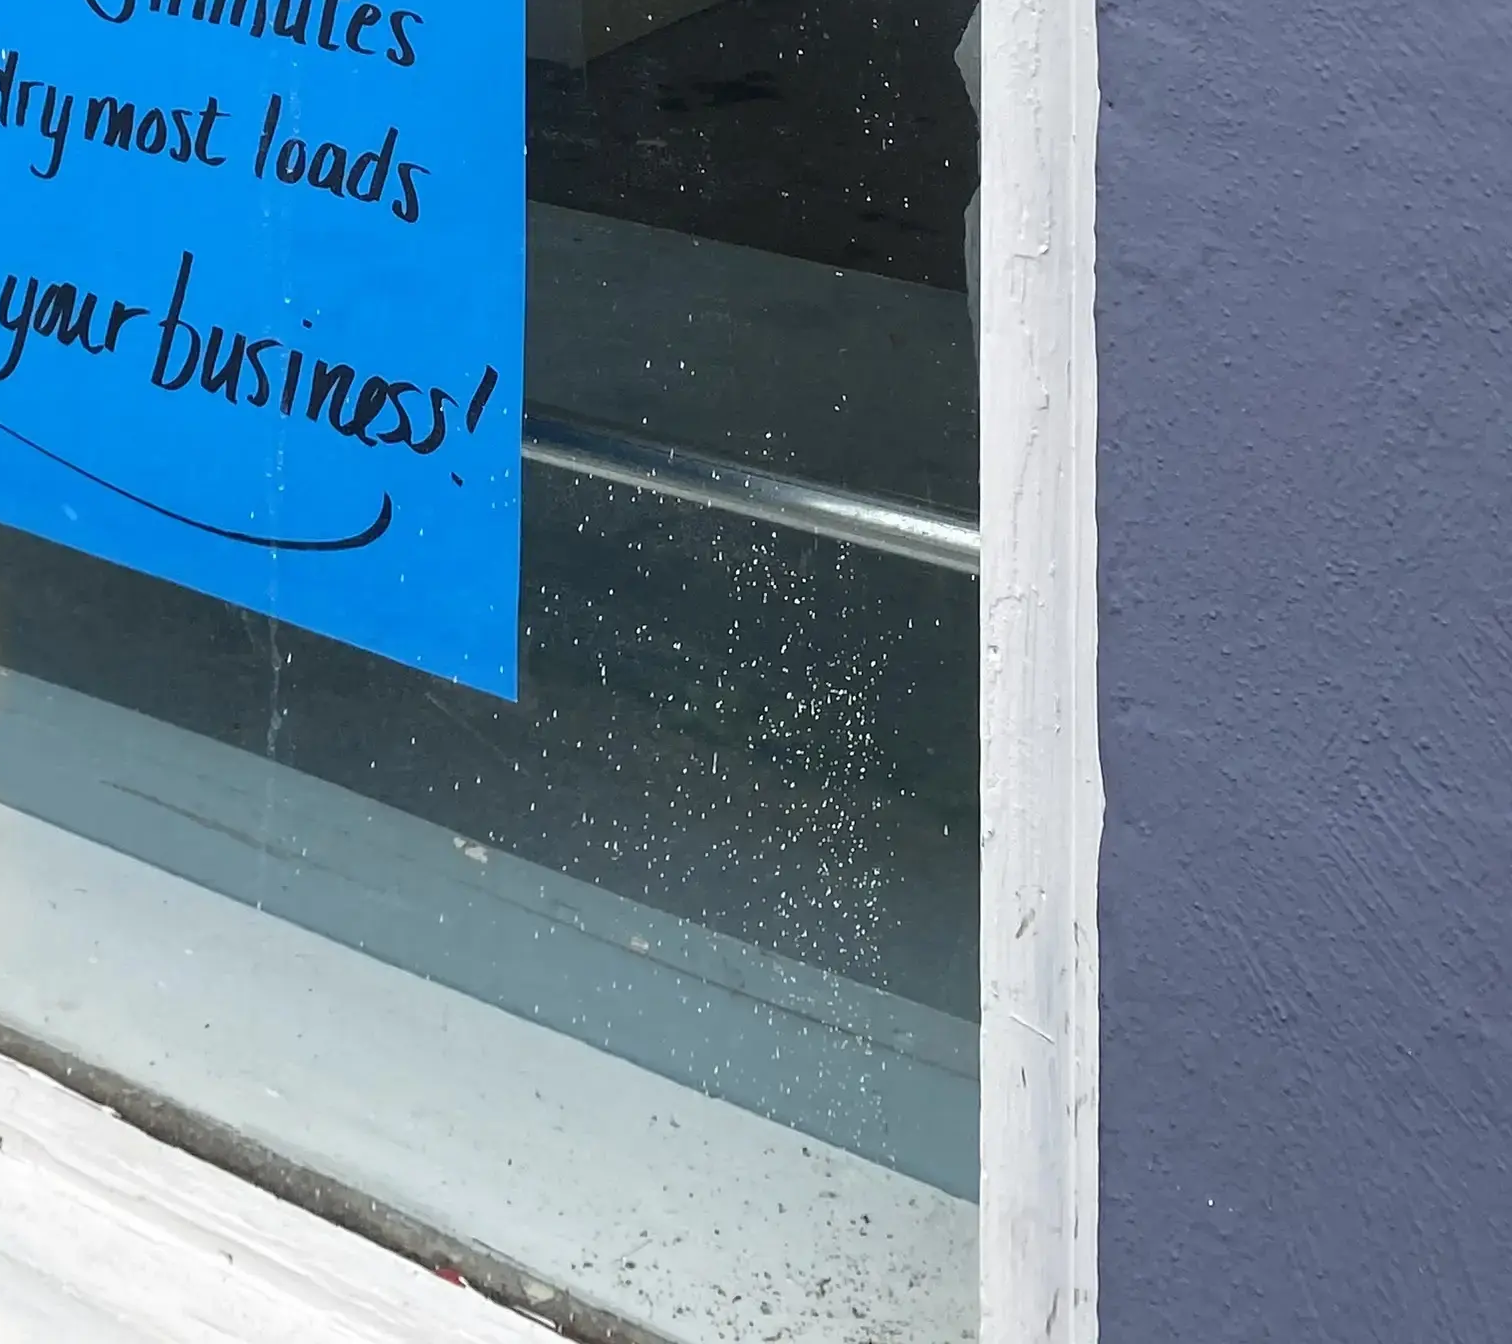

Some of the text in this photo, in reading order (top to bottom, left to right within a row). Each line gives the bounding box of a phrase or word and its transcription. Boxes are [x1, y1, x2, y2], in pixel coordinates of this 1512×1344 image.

[84, 94, 233, 169] most
[253, 93, 430, 224] loads
[150, 250, 500, 488] business!
